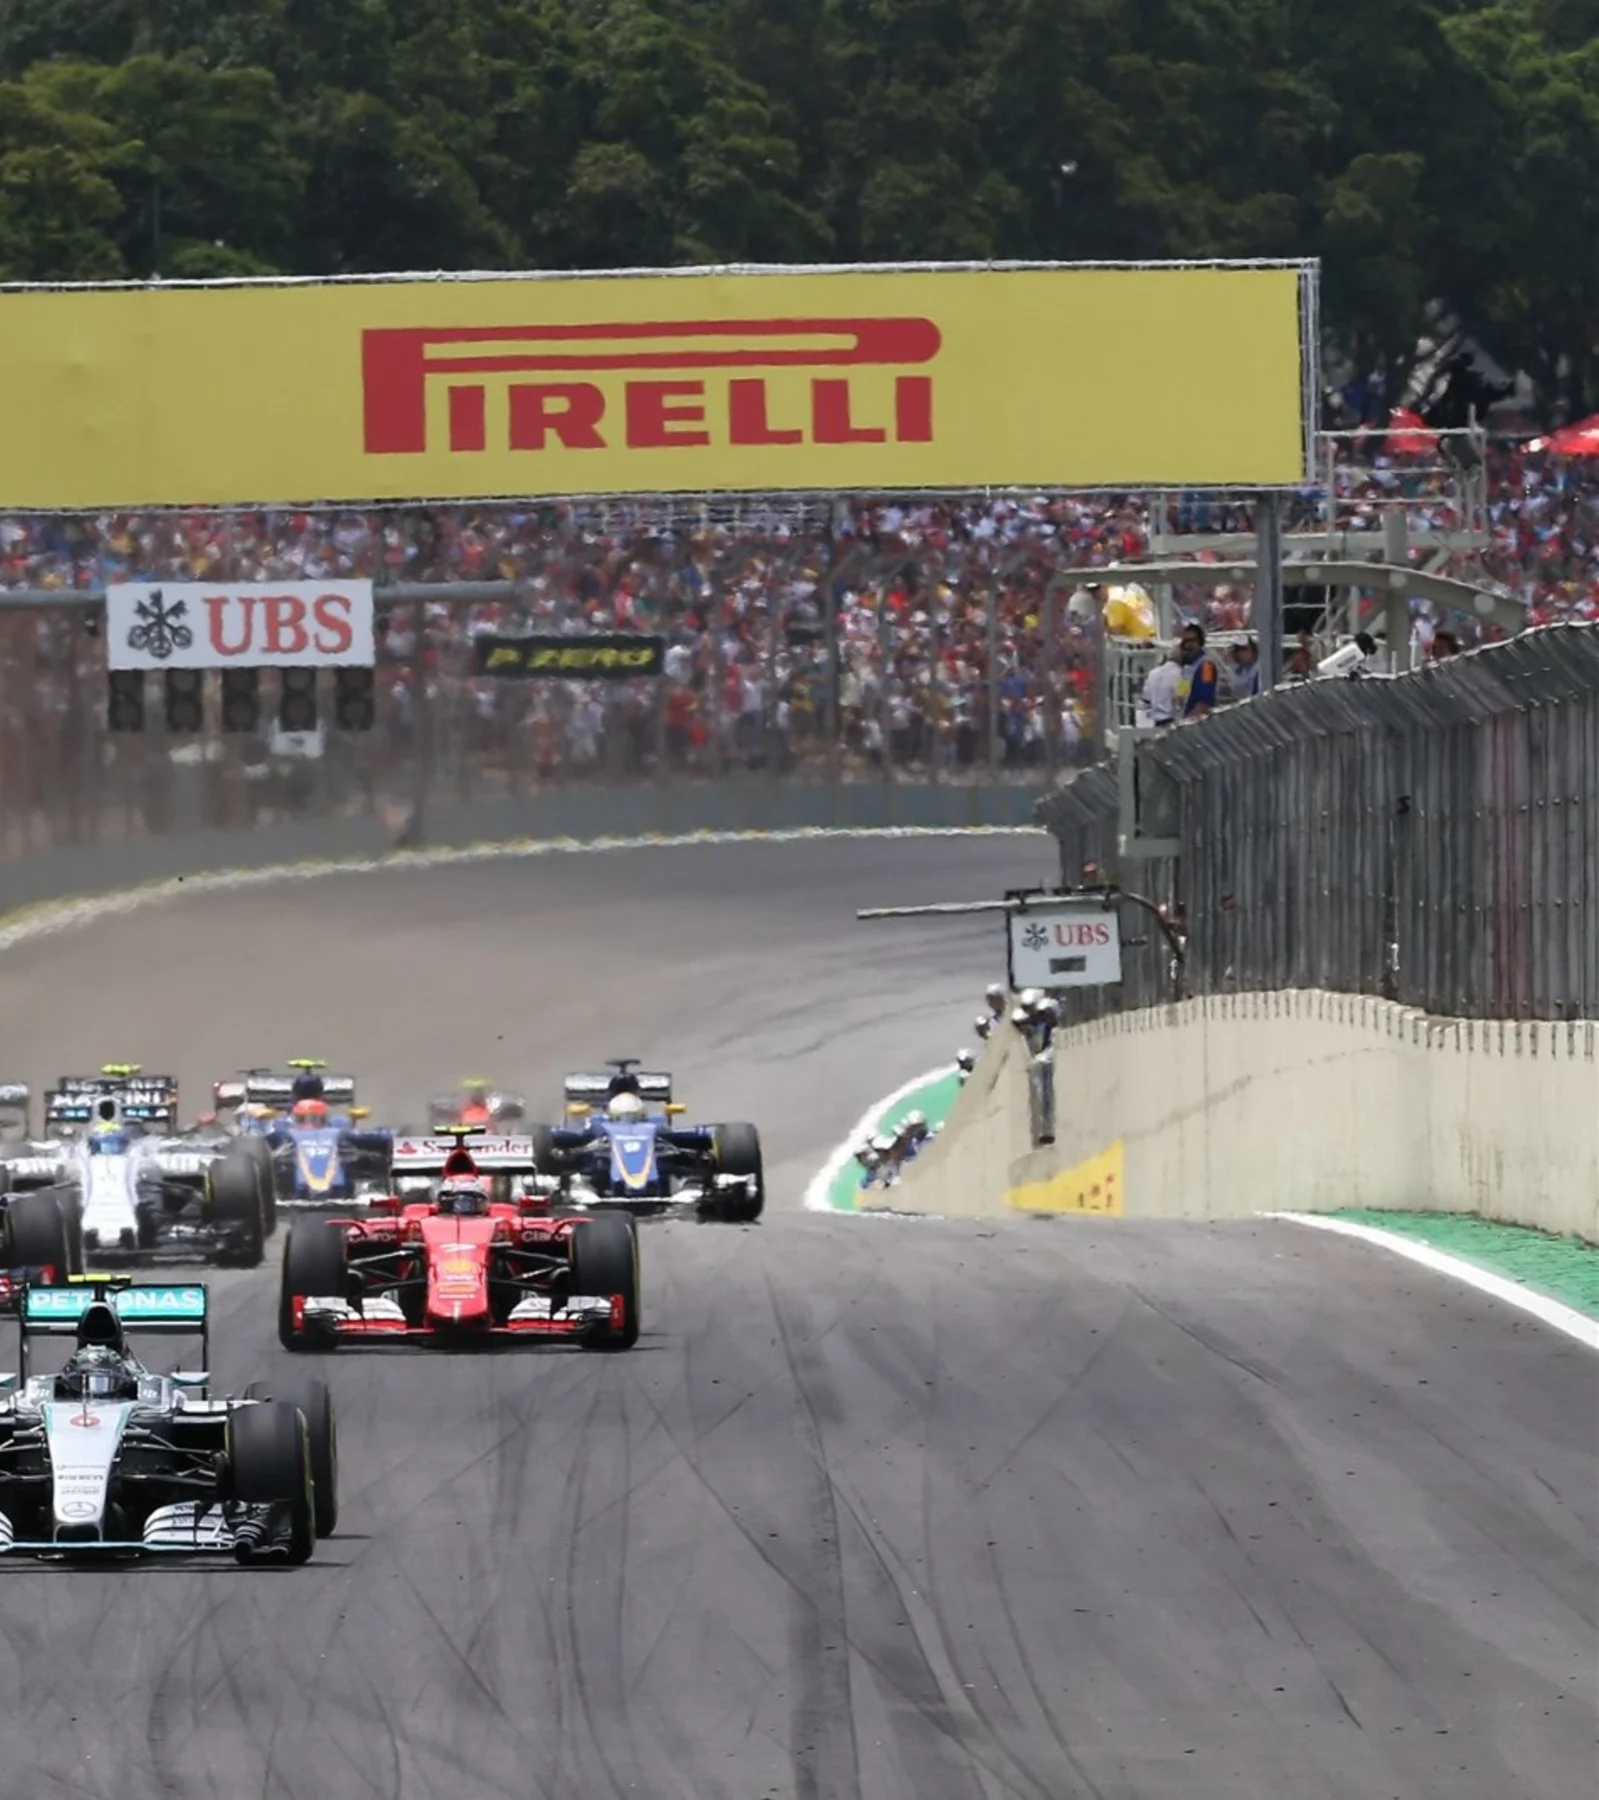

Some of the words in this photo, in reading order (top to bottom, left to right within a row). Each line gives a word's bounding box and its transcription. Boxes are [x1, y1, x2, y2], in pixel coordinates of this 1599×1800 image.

[364, 320, 940, 452] PIRELLI
[204, 595, 354, 655] UBS
[1053, 923, 1110, 947] UBS
[31, 1289, 200, 1311] PETONAS
